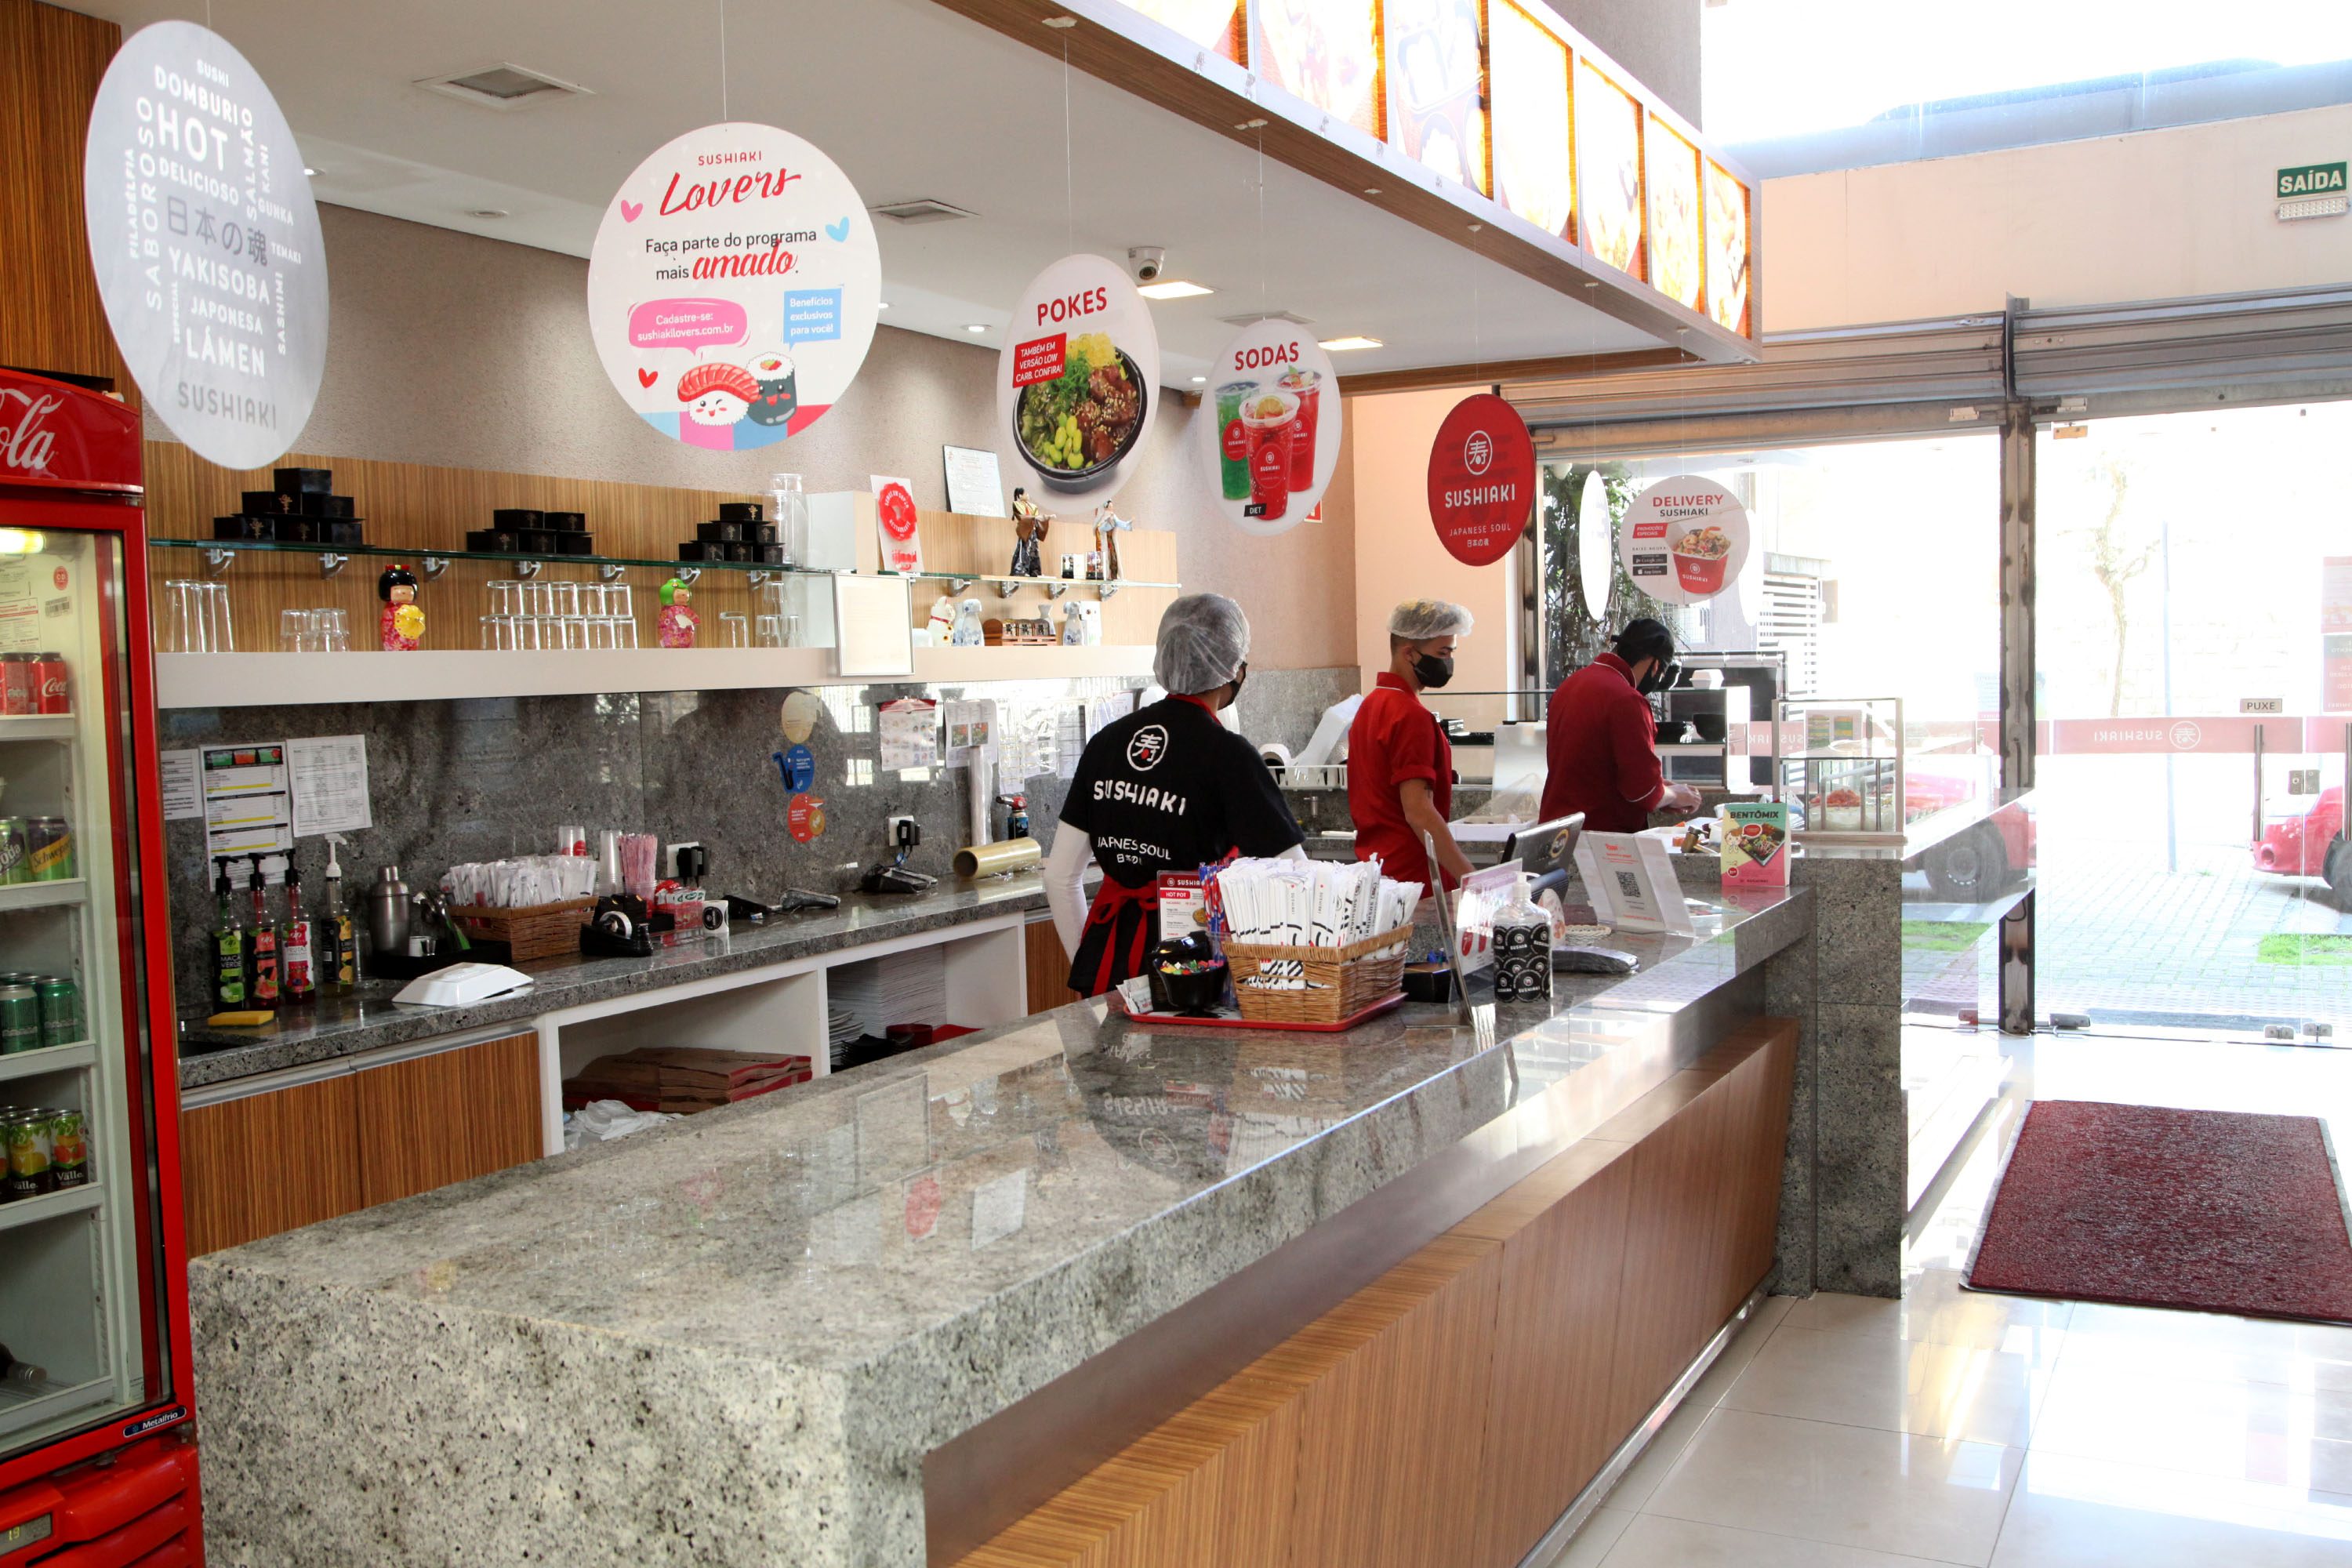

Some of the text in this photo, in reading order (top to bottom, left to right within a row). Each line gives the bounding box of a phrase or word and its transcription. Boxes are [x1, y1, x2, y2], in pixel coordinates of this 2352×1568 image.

[197, 59, 230, 88] SUSHI
[154, 64, 238, 126] DOMBURI
[158, 102, 228, 171] HOT
[241, 107, 257, 223] SALMÃO
[260, 144, 270, 194] KANI
[698, 150, 763, 166] SUSHIAKI
[159, 156, 239, 207] DELICIOSO
[659, 167, 802, 216] Lovers
[2279, 169, 2343, 194] SAÍDA
[136, 96, 162, 311] SABOROSO
[168, 195, 268, 267] 日本の魂
[645, 227, 817, 256] Faça parte do programa
[271, 242, 301, 264] TEMAKI
[169, 245, 270, 306] YAKISOBA
[655, 264, 690, 281] mais
[275, 272, 286, 356] SASHIMI
[789, 296, 833, 308] Benefícios
[1036, 285, 1108, 327] POKES
[191, 295, 263, 336] JAPONESA
[655, 311, 714, 326] Cadastre-se:
[790, 310, 833, 322] exclusivos
[637, 323, 735, 342] sushiakilovers.com.br
[790, 323, 833, 337] para você!
[186, 325, 265, 377] LÁMEN
[1018, 352, 1058, 370] VERSÃO LOW
[1020, 340, 1056, 358] TAMBÉM EM
[1235, 341, 1299, 371] SODAS
[1033, 363, 1063, 380] CONFIRA!
[177, 382, 277, 430] SUSHIAKI
[1444, 483, 1516, 510] SUSHIAKI
[1653, 494, 1725, 508] DELIVERY
[1249, 506, 1261, 515] DIET
[1659, 507, 1708, 517] SUSHIAKI
[1449, 523, 1512, 537] JAPANESE SOUL
[2246, 702, 2276, 710] PUXE
[1093, 779, 1187, 816] SUSHIAKI
[1730, 810, 1779, 819] BENTÔMIX
[1138, 843, 1171, 861] SOUL
[142, 1412, 178, 1430] Metalfrio
